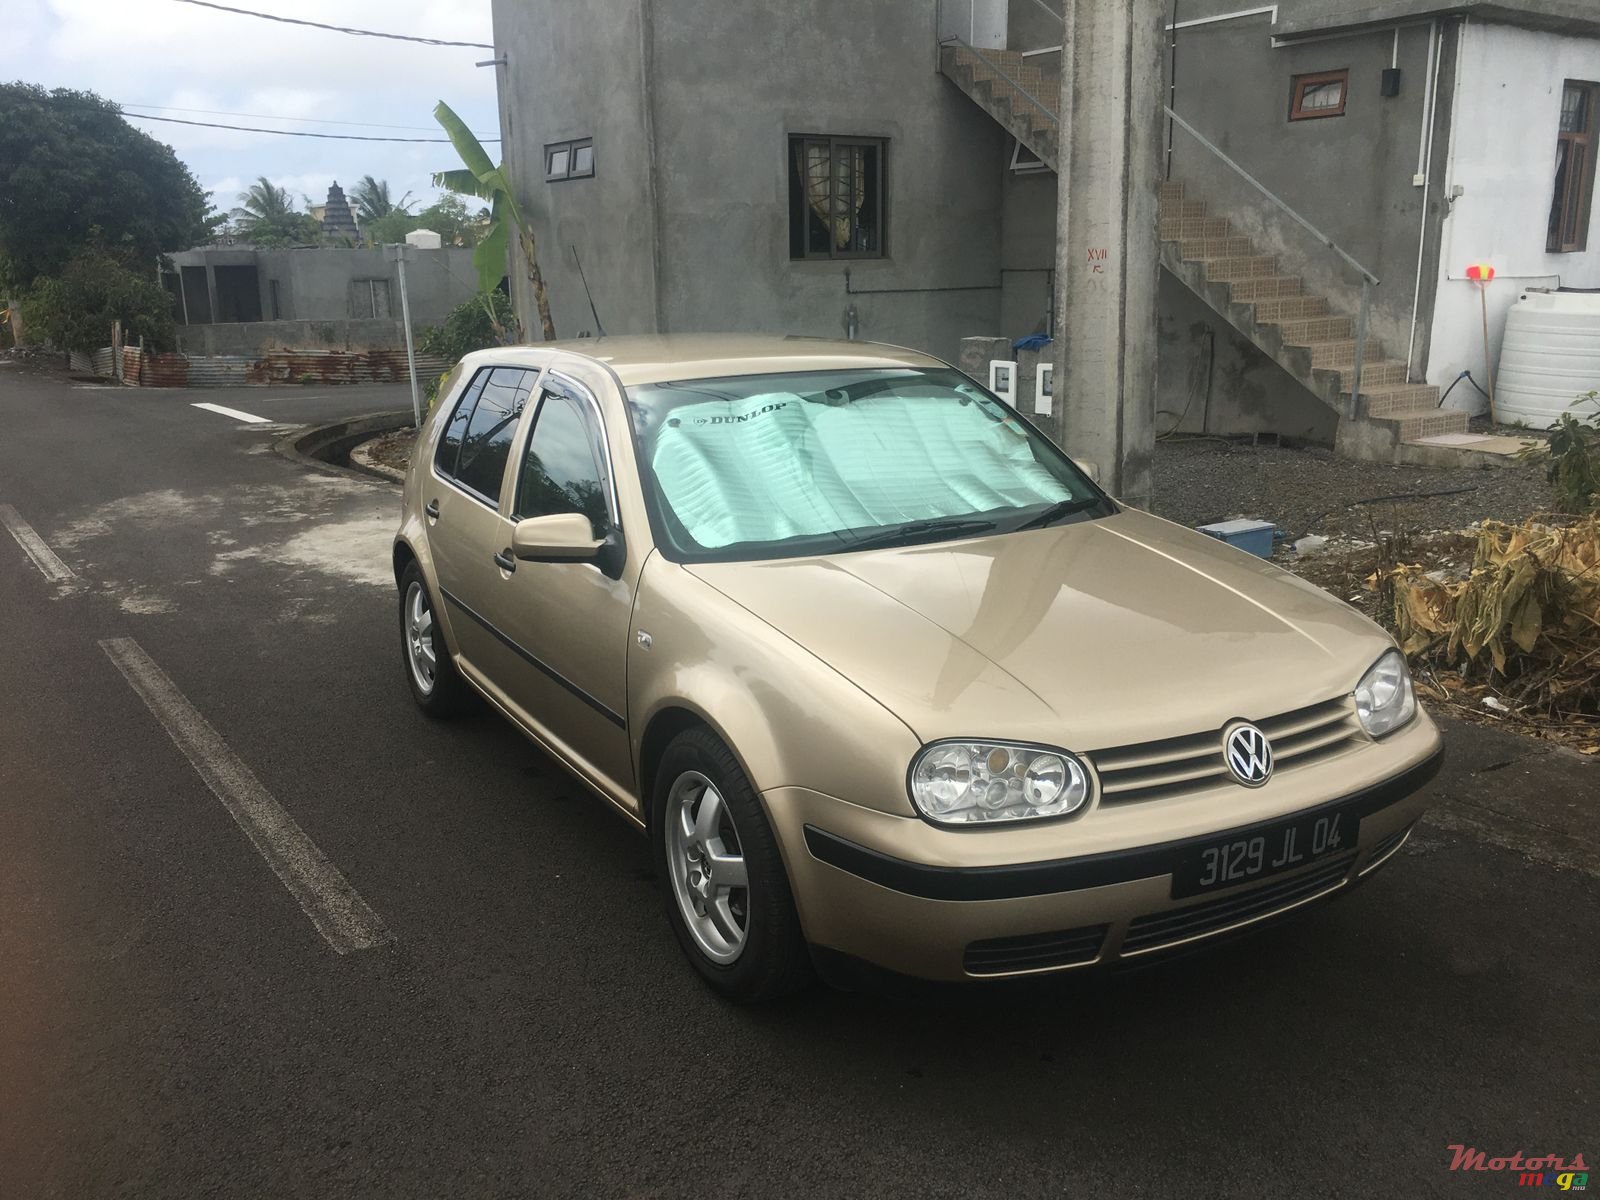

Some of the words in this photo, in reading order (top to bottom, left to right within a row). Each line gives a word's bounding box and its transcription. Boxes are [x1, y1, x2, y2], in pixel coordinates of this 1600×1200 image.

[710, 402, 787, 425] DUNLOP
[1200, 837, 1265, 886] 3129
[1272, 827, 1303, 868] JL
[1312, 813, 1342, 854] 04
